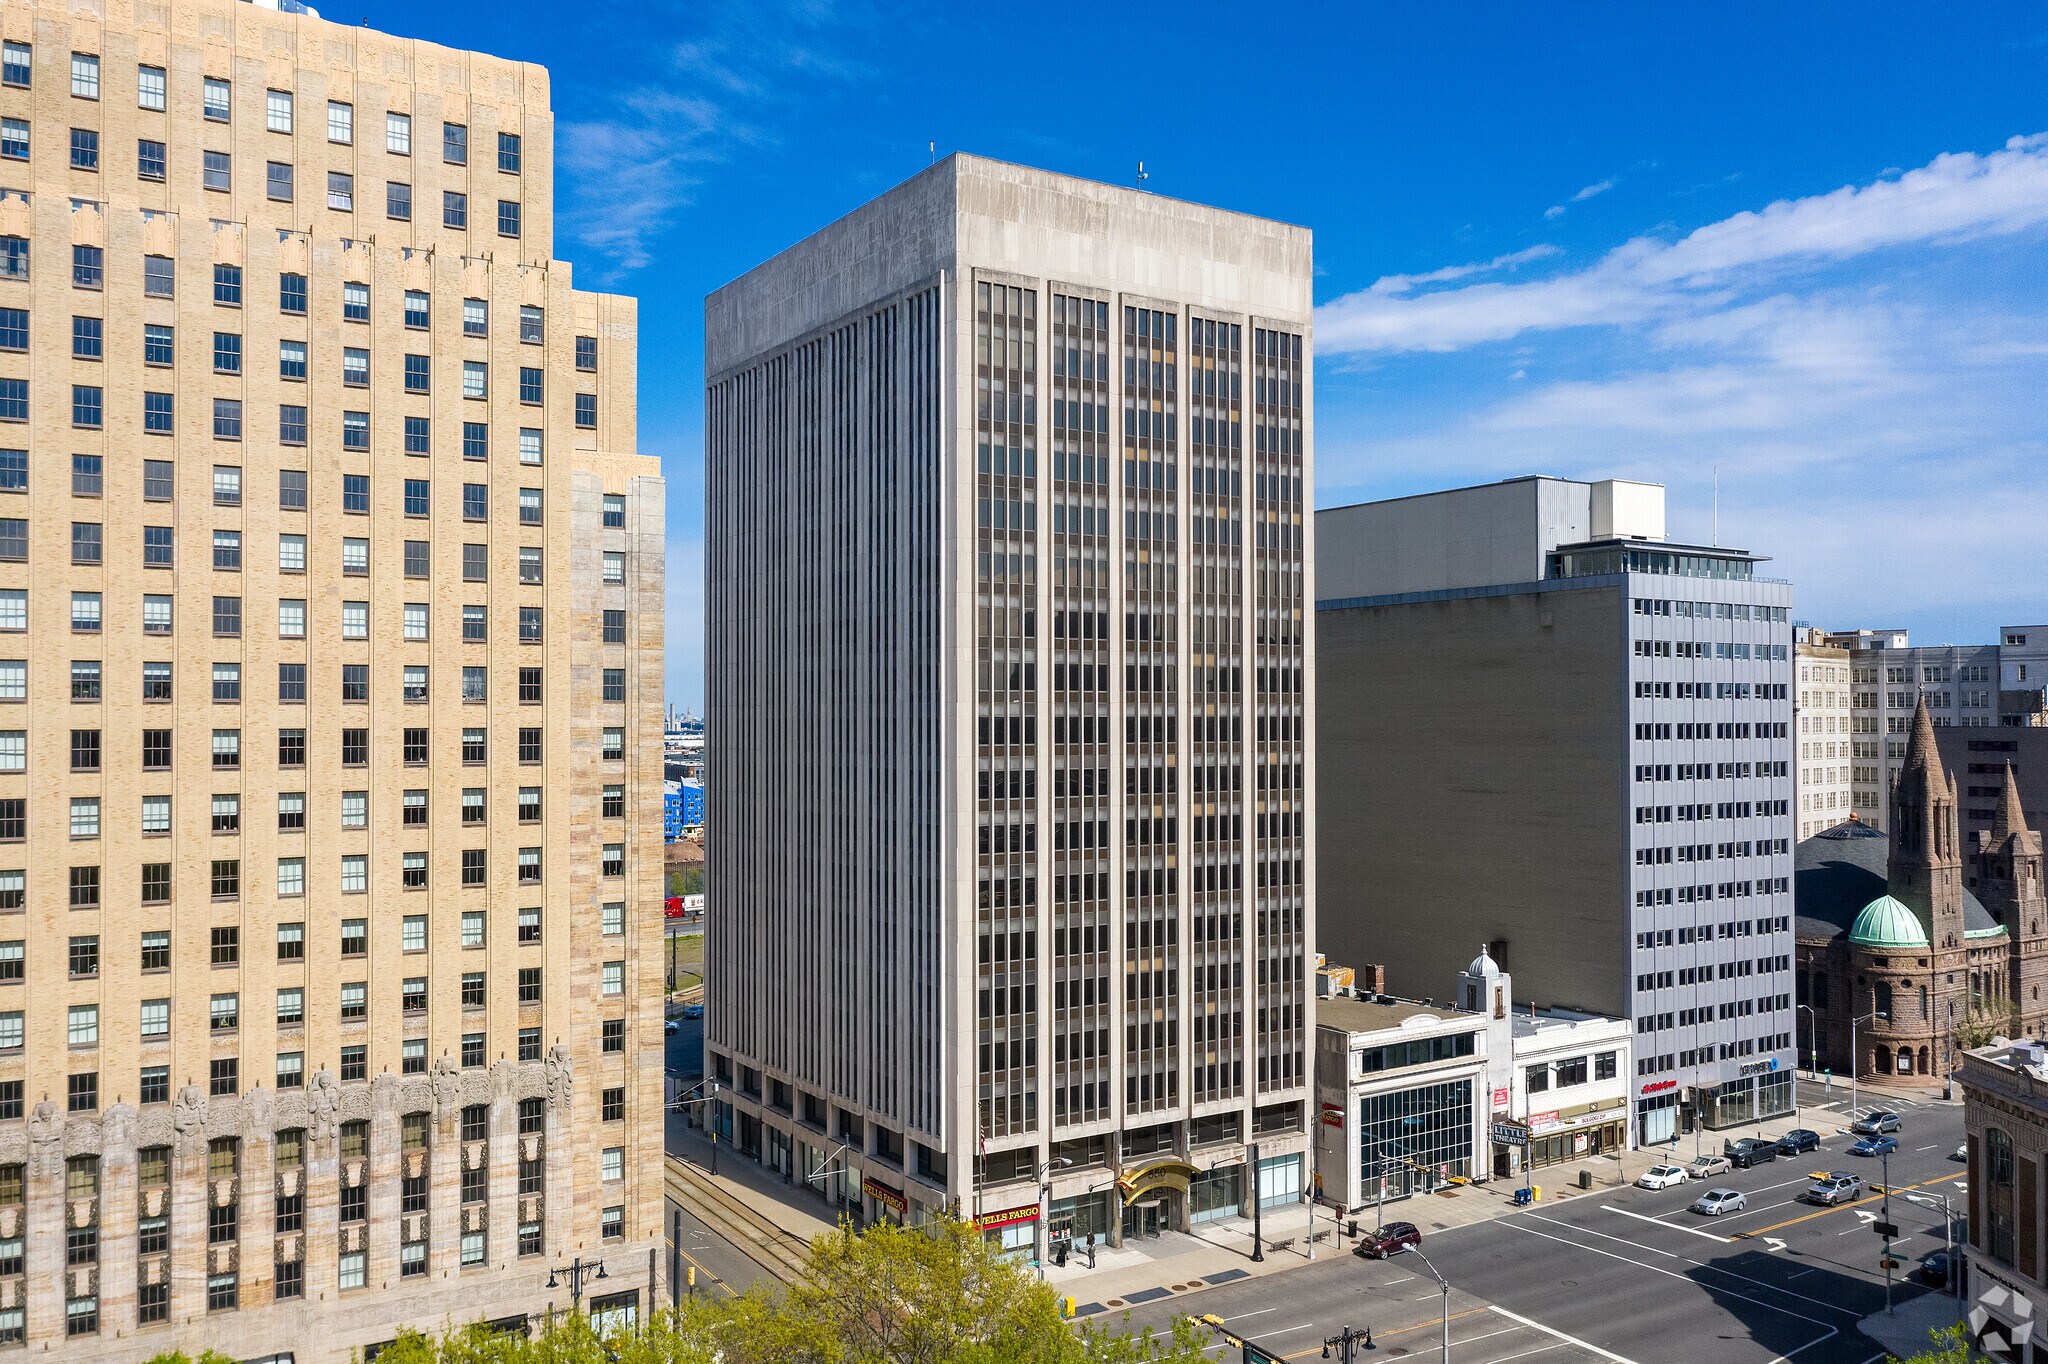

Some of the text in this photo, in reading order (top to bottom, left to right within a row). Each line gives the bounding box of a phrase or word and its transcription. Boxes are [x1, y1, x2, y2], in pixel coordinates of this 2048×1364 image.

[1494, 1126, 1527, 1138] LITTLE
[1148, 1168, 1166, 1179] 550
[864, 1183, 904, 1211] WELLS FARGO
[976, 1207, 1039, 1226] WELLS FARGO
